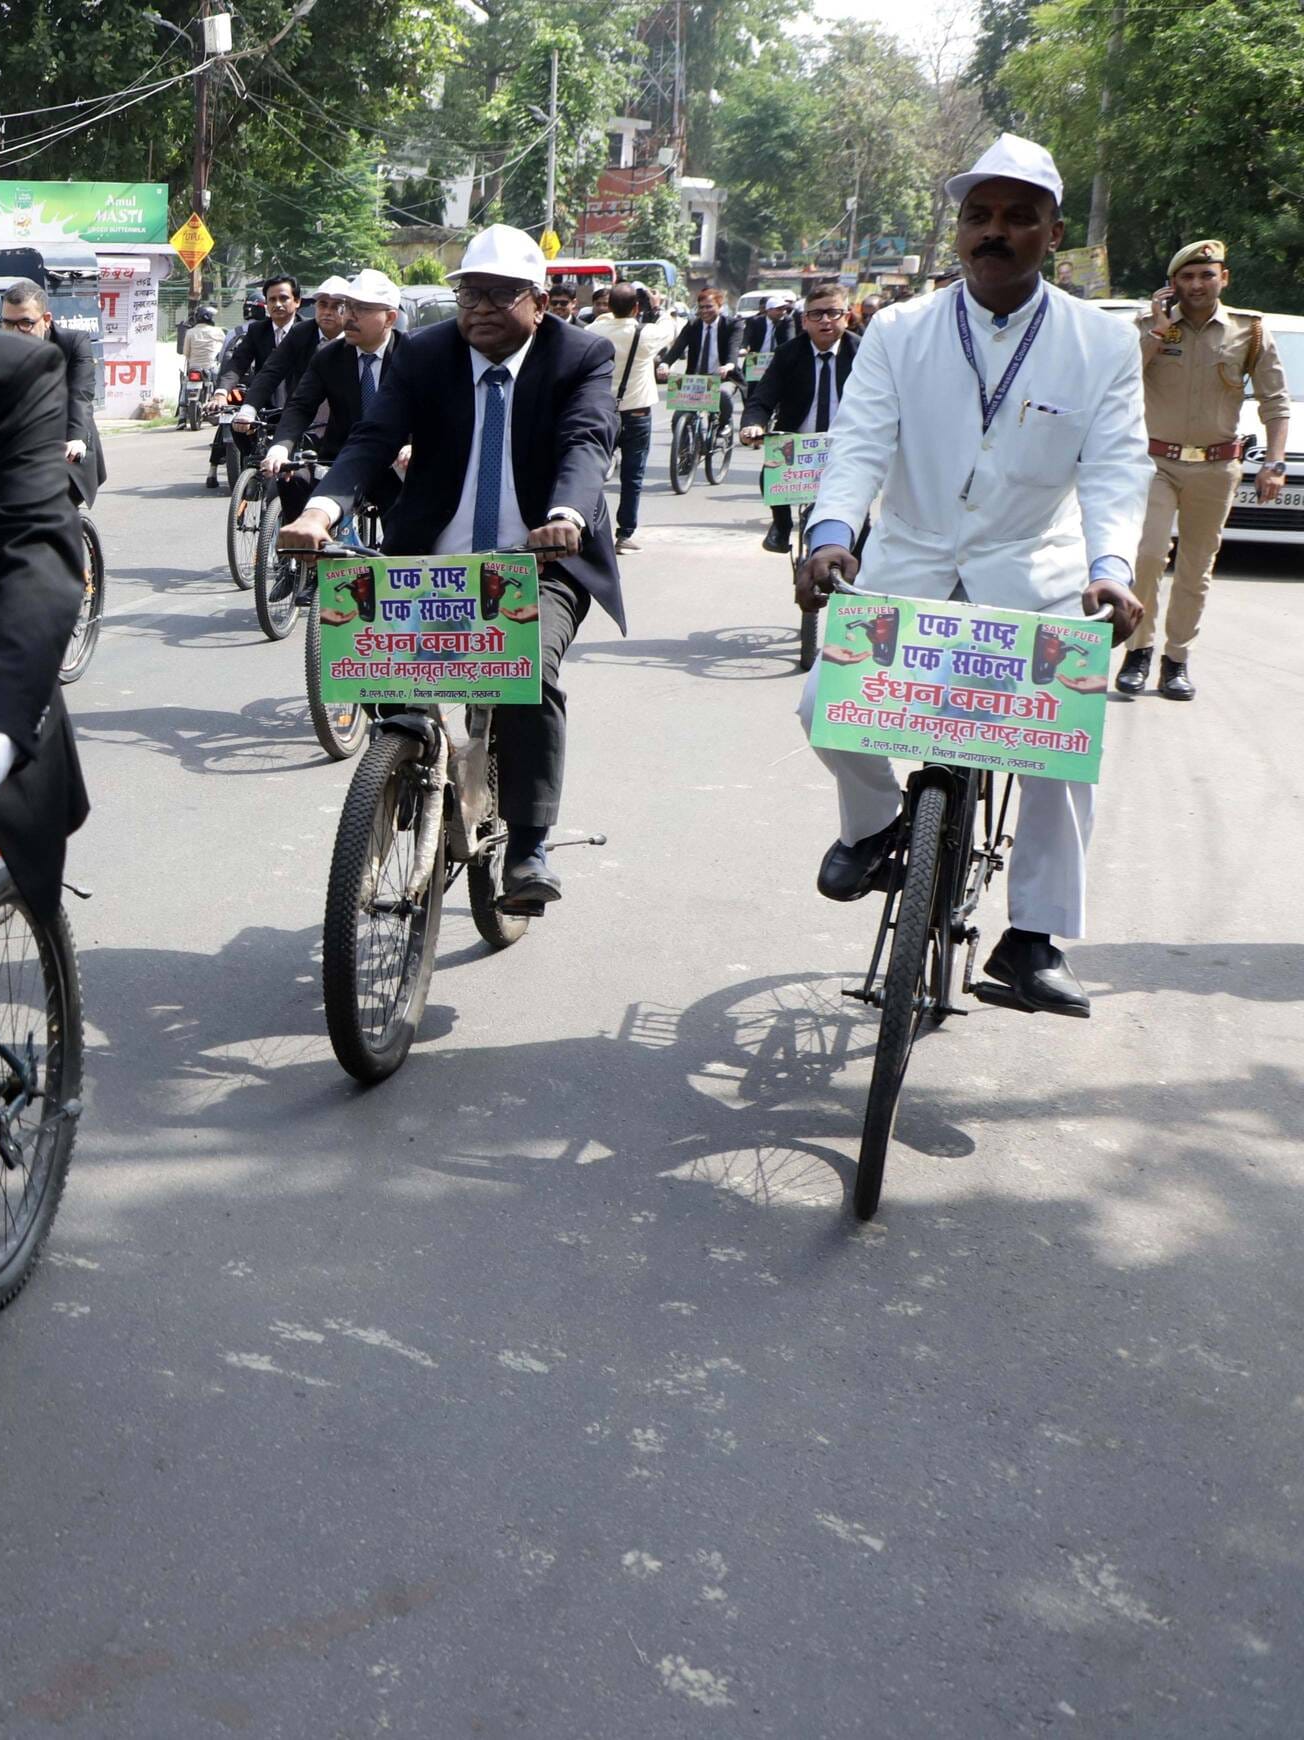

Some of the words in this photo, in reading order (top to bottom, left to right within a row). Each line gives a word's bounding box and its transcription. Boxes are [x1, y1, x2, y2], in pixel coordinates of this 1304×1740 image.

[106, 194, 136, 207] Amul
[96, 208, 143, 223] MASTI
[1014, 341, 1030, 361] Court
[1275, 492, 1304, 506] 688
[326, 569, 346, 580] SAVE
[347, 566, 370, 577] FUEL
[388, 568, 422, 590] एक
[429, 567, 467, 593] राष्ट्र
[484, 562, 506, 572] SAVE
[508, 565, 529, 575] FUEL
[380, 599, 412, 622] एक
[418, 592, 477, 622] संकल्प
[838, 607, 863, 616] SAVE
[867, 606, 895, 616] FUEL
[422, 626, 506, 653] बचाओ
[917, 614, 962, 638] एक
[971, 619, 1020, 650] राष्ट्र
[1042, 624, 1071, 637] SAVE
[1073, 631, 1101, 644] FUEL
[331, 657, 366, 680] हरित
[370, 656, 391, 679] एवं
[394, 661, 444, 684] मज़बूत
[447, 661, 480, 683] राष्ट्र
[481, 656, 533, 680] बनाओ
[902, 645, 944, 670] एक
[952, 645, 1027, 682] संकल्प
[949, 688, 1060, 721] बचाओ
[827, 701, 874, 726] हरित
[878, 706, 907, 731] एवं
[910, 713, 977, 745] मज़बूत
[979, 722, 1021, 748] राष्ट्र
[1023, 728, 1090, 754] बनाओ
